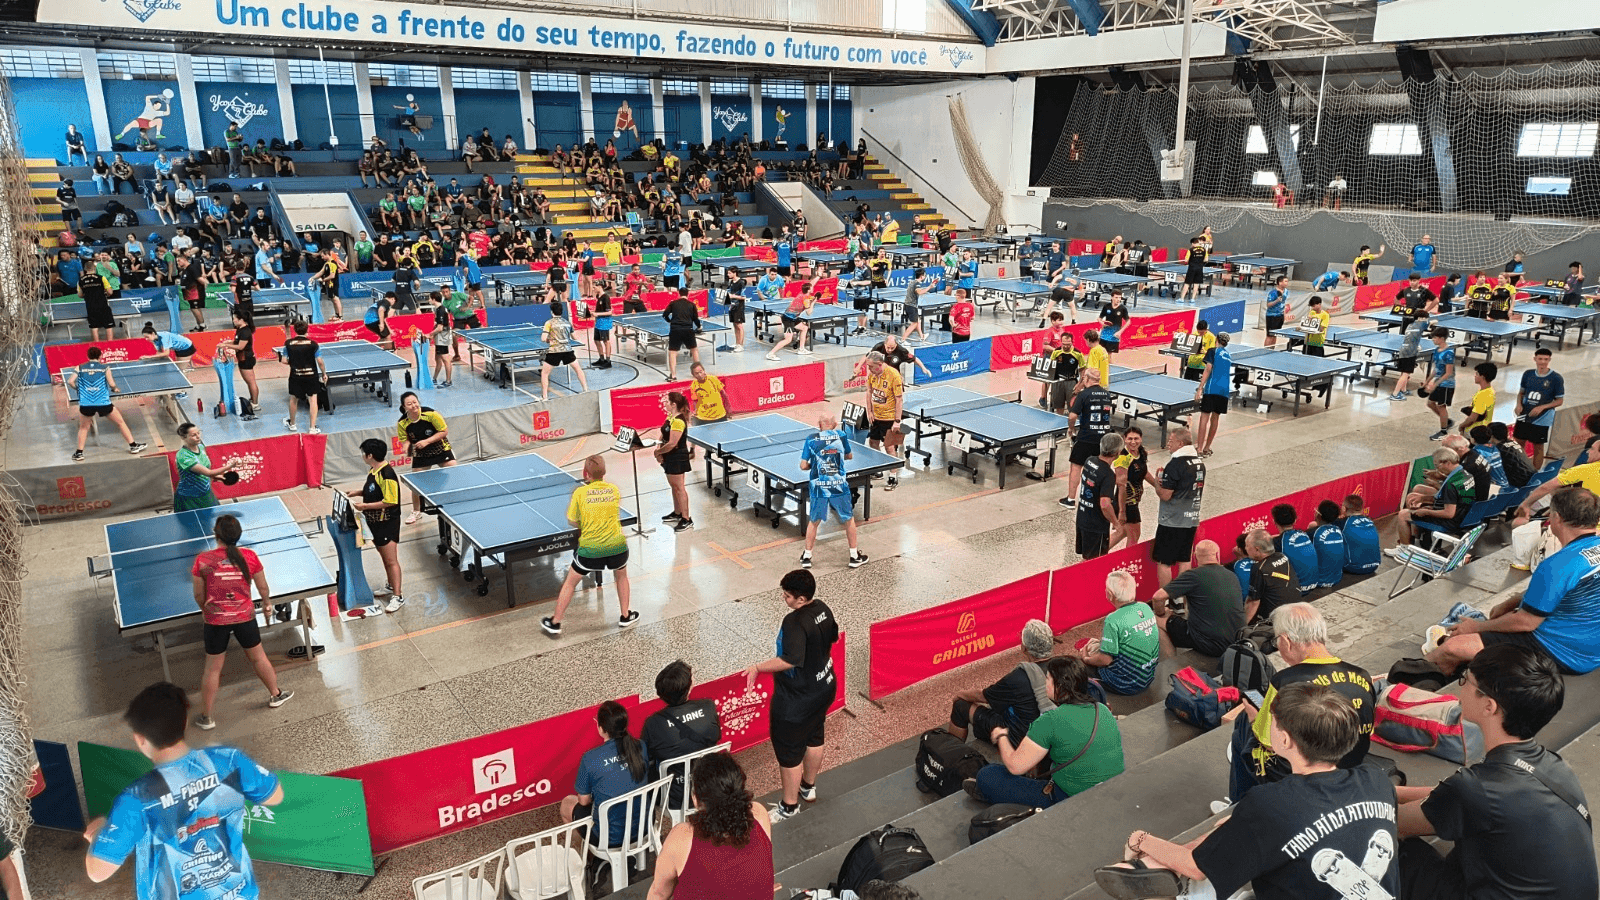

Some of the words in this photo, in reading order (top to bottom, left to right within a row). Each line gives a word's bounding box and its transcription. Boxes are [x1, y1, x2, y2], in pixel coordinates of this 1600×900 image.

[216, 0, 269, 27] Um
[282, 3, 359, 31] clube
[371, 14, 387, 34] a
[398, 10, 485, 39] frente
[497, 17, 525, 43] do
[535, 25, 578, 46] seu
[588, 25, 665, 56] tempo,
[676, 30, 757, 56] fazendo
[764, 41, 775, 57] o
[783, 37, 840, 61] futuro
[847, 46, 882, 63] com
[295, 222, 338, 231] SAÍDA
[1527, 314, 1535, 323] 2
[1448, 331, 1455, 339] 3
[1364, 348, 1373, 359] 4
[941, 360, 969, 373] TAUSTE
[843, 378, 867, 389] Brade
[1256, 370, 1271, 383] 25
[758, 393, 796, 406] Bradesco
[1123, 398, 1131, 410] 6
[520, 427, 565, 444] Bradesco
[957, 431, 966, 445] 7
[751, 469, 759, 484] 8
[36, 499, 112, 515] Bradesco
[453, 529, 461, 547] 9
[932, 633, 996, 665] CRIATIVO
[1331, 670, 1346, 683] de
[1347, 671, 1371, 692] Mesa
[1513, 758, 1536, 774] NIKE
[181, 771, 221, 800] PIGOZZI
[187, 796, 199, 811] SP
[437, 778, 552, 828] Bradesco
[1281, 827, 1319, 859] TAMO
